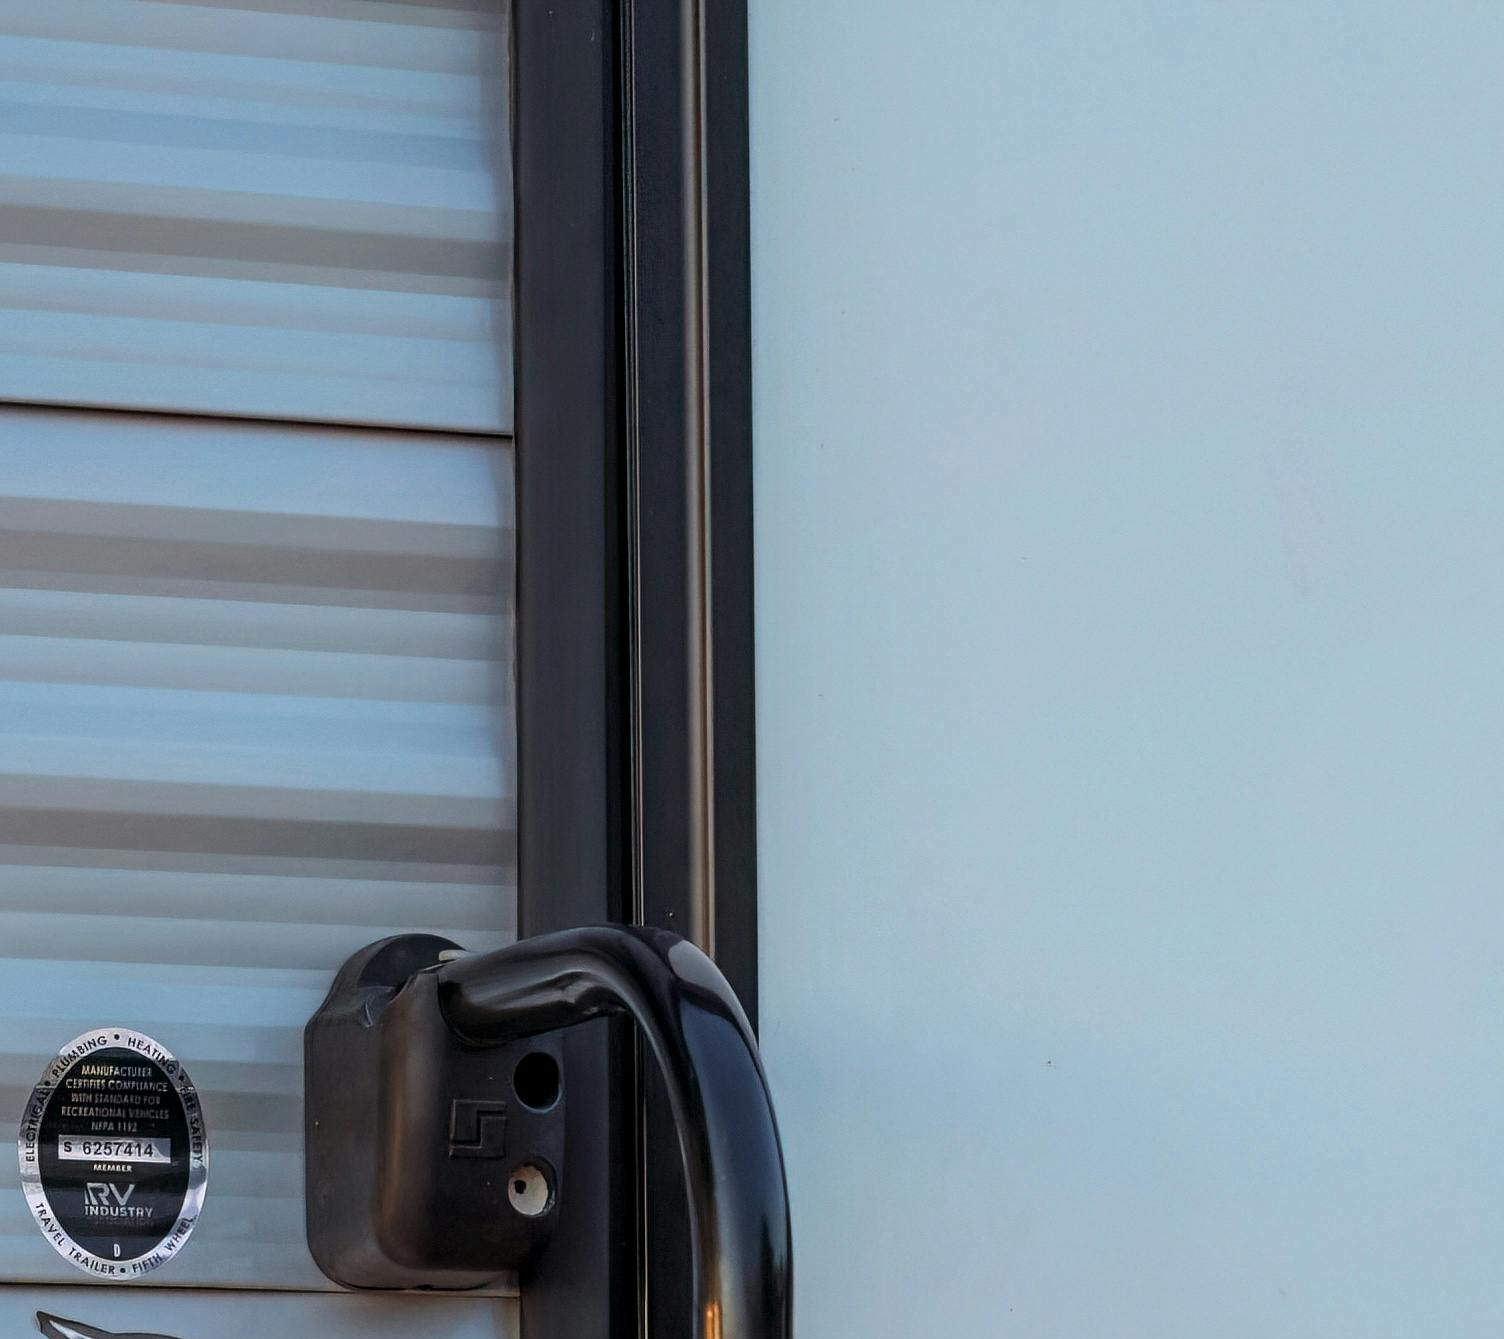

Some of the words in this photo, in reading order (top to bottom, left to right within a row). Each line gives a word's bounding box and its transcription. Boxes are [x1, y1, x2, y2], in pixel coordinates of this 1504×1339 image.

[53, 1035, 107, 1077] PLUMBING
[127, 1037, 176, 1075] HEATING
[81, 1064, 153, 1078] MANUFACTURER
[65, 1078, 106, 1090] CERTIFIES
[108, 1079, 169, 1093] COMPLIANCE
[94, 1093, 141, 1105] STANDARD
[61, 1105, 126, 1119] RECREATIONAL
[128, 1107, 170, 1120] VEHICLES
[191, 1117, 203, 1163] SAFETY
[63, 1141, 73, 1153] S
[82, 1141, 154, 1158] 6257414
[93, 1163, 133, 1173] MEMBER
[84, 1182, 136, 1206] RV
[84, 1206, 154, 1218] INDUSTRY
[35, 1203, 64, 1247] TRAVEL
[68, 1246, 116, 1275] TRAILER
[132, 1254, 163, 1274] FIFTH
[165, 1215, 196, 1254] WHEEL
[113, 1243, 121, 1258] D
